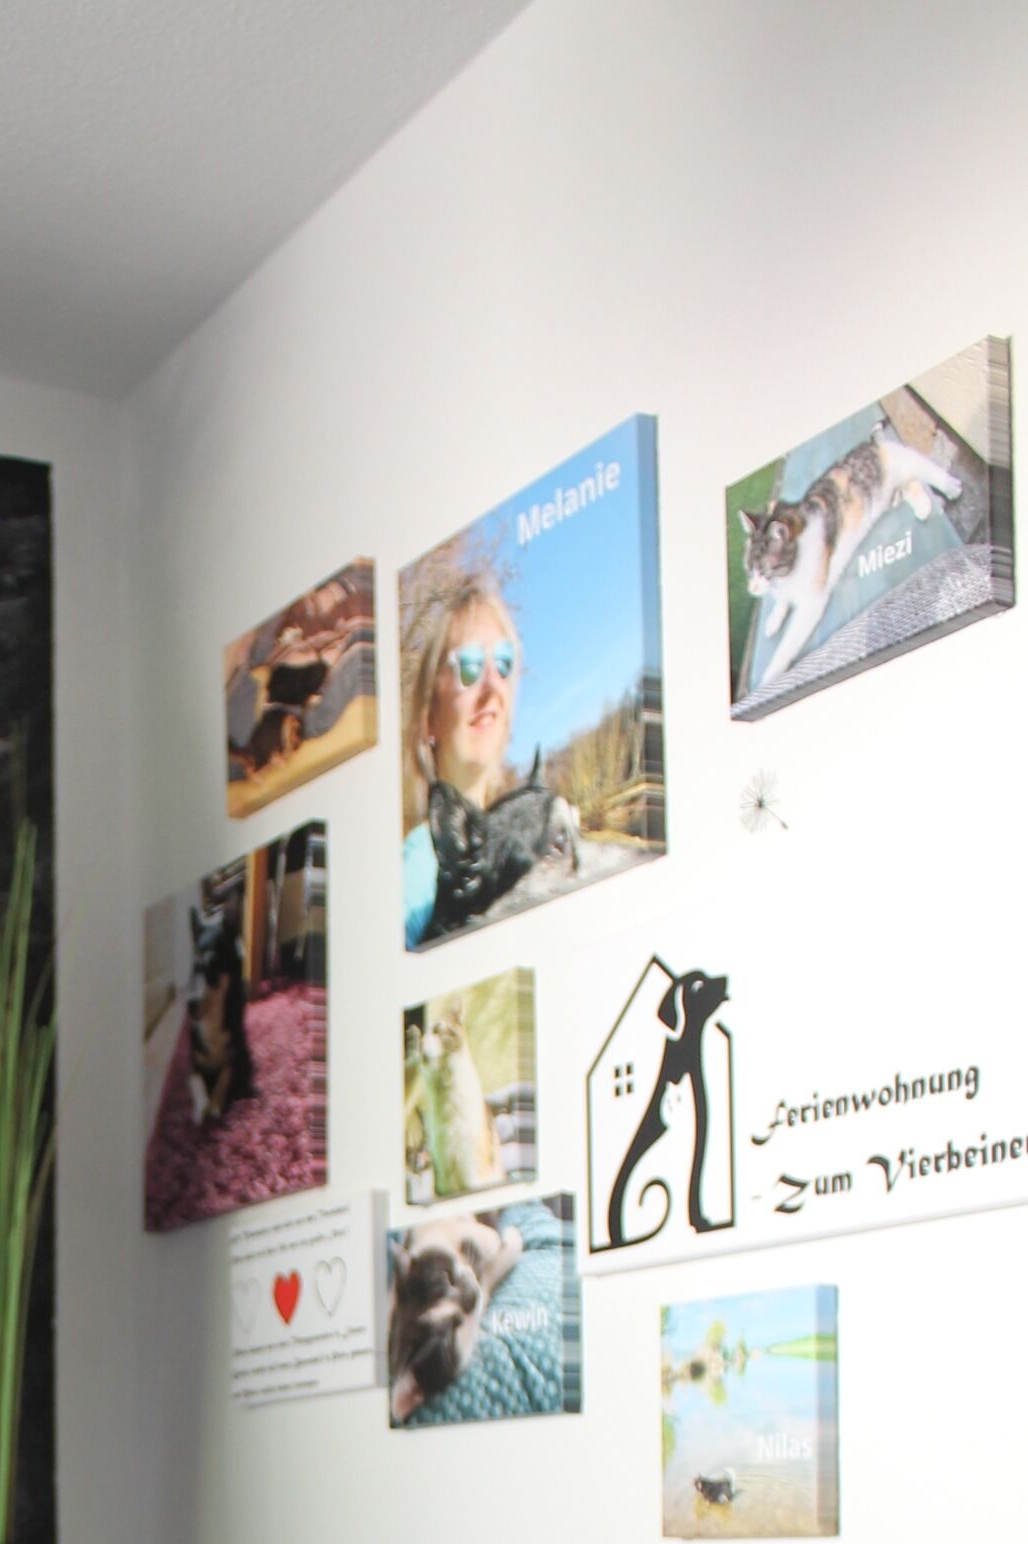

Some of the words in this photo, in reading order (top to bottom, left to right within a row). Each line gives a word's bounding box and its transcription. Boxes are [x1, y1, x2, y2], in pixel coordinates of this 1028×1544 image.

[516, 461, 621, 545] Melanie
[858, 530, 912, 578] Miezi
[751, 1065, 980, 1146] Ferienwohnung
[774, 1173, 852, 1214] Zum
[866, 1133, 1028, 1193] Vierbeine
[757, 1431, 813, 1461] Nilas
